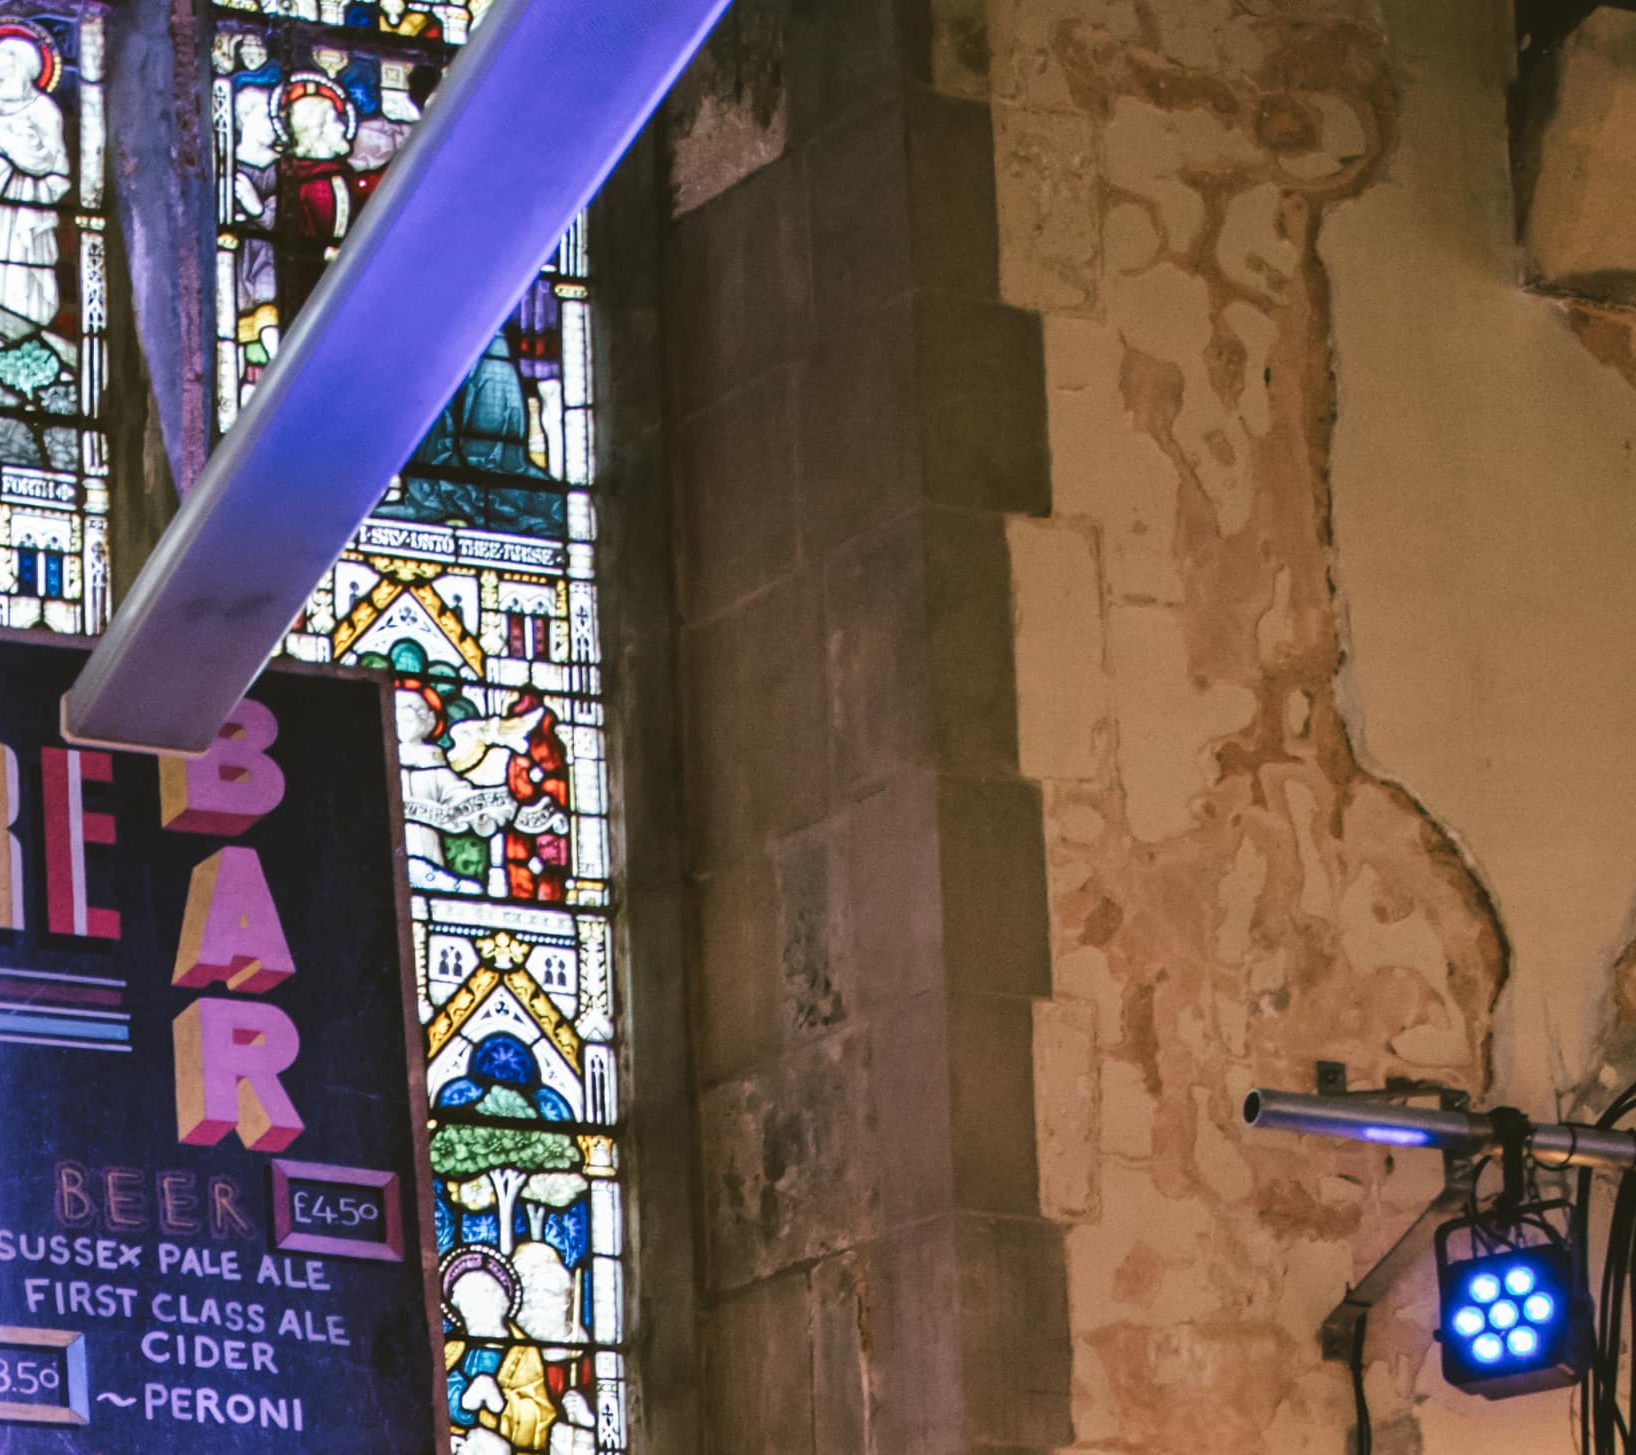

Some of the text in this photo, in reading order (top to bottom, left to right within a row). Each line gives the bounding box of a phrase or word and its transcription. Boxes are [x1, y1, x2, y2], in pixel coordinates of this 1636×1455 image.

[1, 476, 55, 499] FORTH
[159, 698, 305, 1152] BAR
[54, 1158, 258, 1241] BEER
[158, 1241, 243, 1281] PALE
[256, 1254, 331, 1292] ALE
[24, 1278, 351, 1347] FIRST CLASS ALE
[140, 1331, 279, 1375] CIDER
